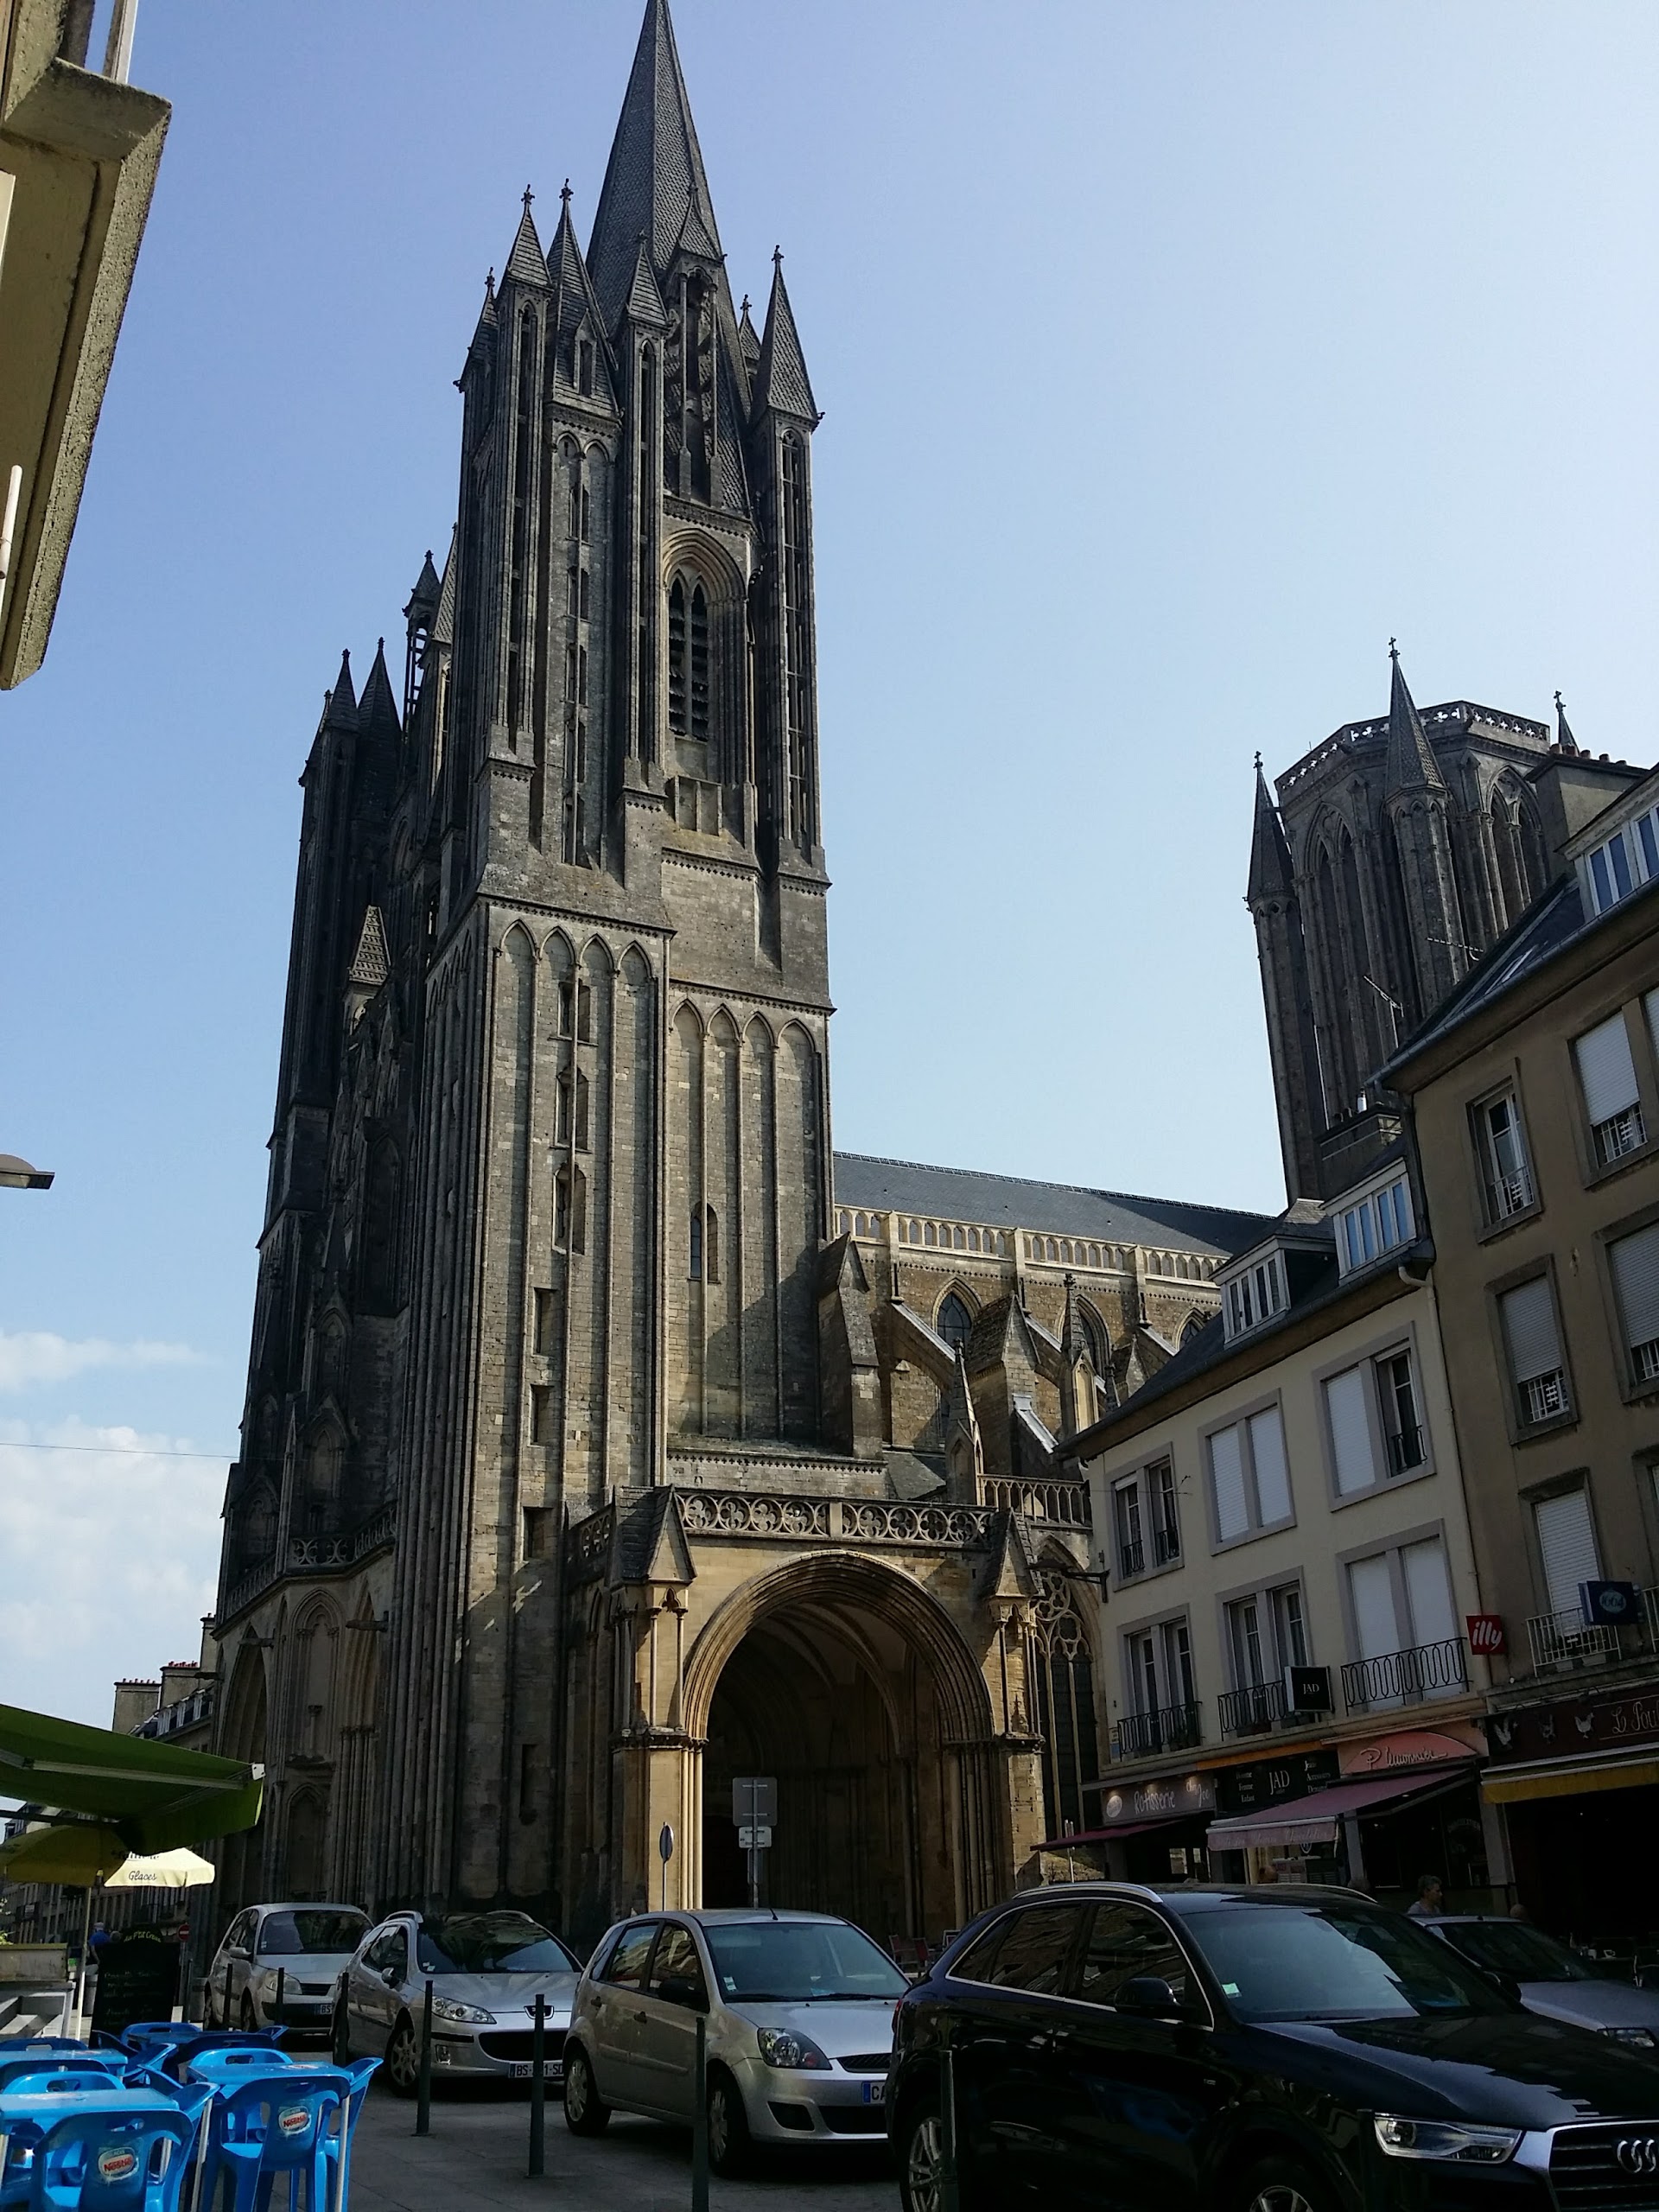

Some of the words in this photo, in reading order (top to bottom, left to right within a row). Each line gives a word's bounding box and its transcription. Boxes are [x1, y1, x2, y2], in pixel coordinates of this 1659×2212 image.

[1472, 1620, 1502, 1651] illy
[1302, 1683, 1320, 1694] JAD
[1611, 1706, 1627, 1734] Le
[1268, 1770, 1291, 1796] JAD
[128, 1871, 157, 1881] Glaces
